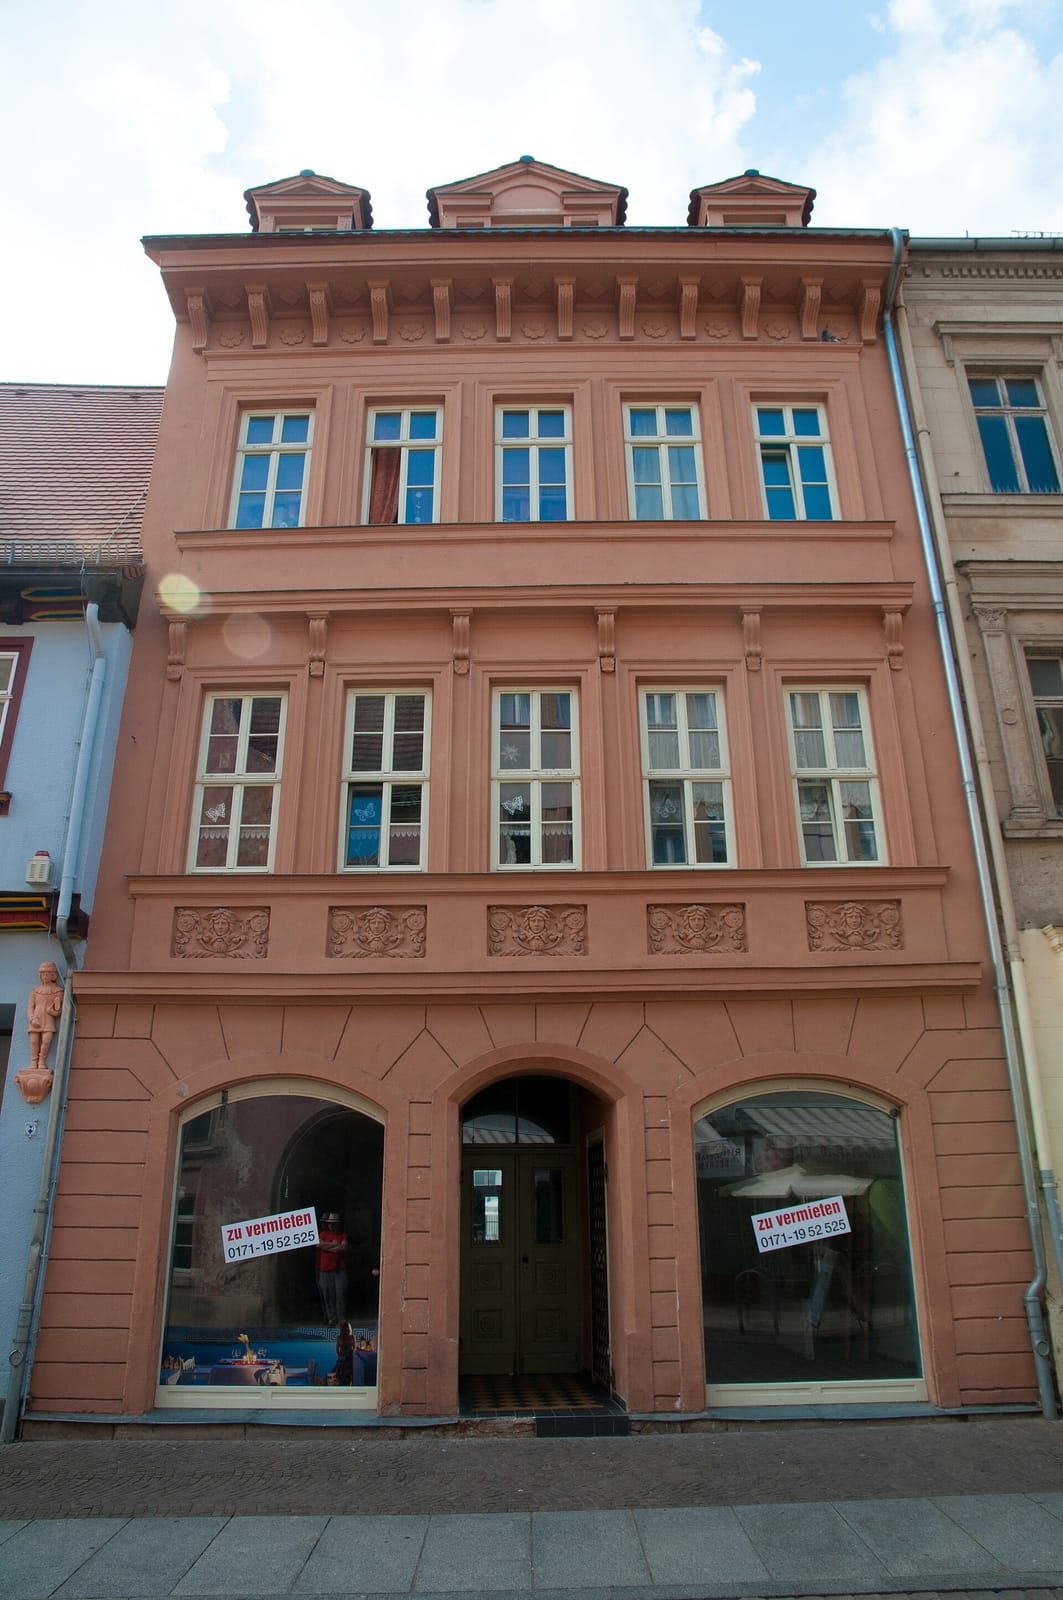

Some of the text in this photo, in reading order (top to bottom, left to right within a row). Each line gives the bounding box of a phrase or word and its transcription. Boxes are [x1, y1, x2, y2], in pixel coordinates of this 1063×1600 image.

[227, 1212, 312, 1242] zu vermieten
[757, 1201, 841, 1231] zu vermieten
